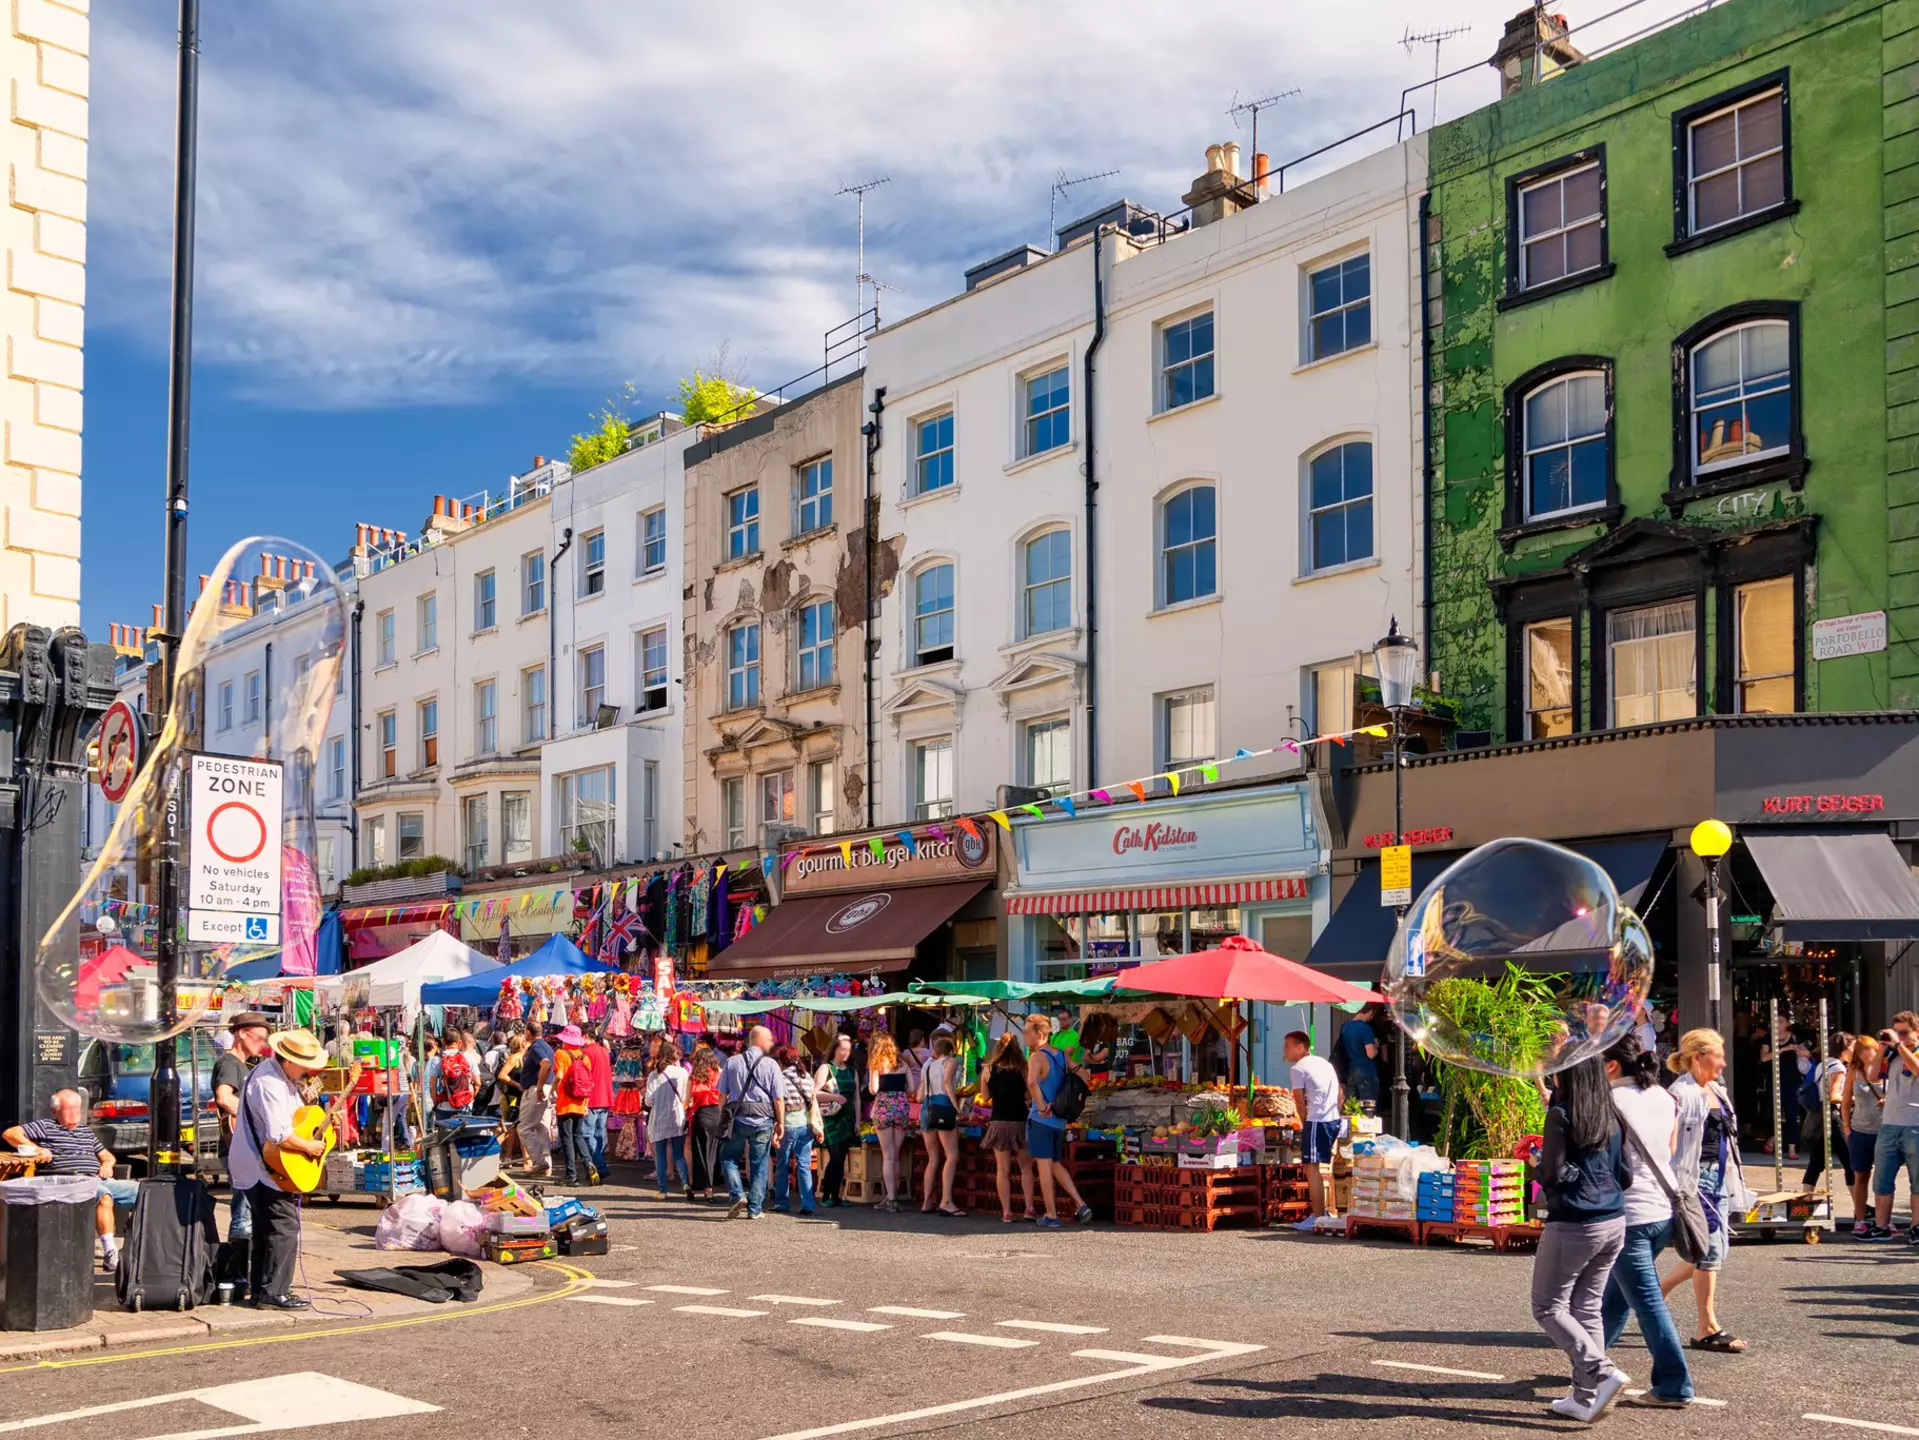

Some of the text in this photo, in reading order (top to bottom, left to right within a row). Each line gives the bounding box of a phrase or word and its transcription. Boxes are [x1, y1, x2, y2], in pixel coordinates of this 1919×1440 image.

[1717, 489, 1767, 516] CITY
[1815, 628, 1884, 646] PORTOBELLO
[197, 761, 278, 779] PEDESTRIAN
[209, 776, 266, 797] ZONE
[1763, 794, 1884, 814] KURT GEIGER
[1112, 822, 1198, 855] Cath Kidston
[1364, 826, 1453, 848] KUR GEIGER
[202, 865, 270, 879] No vehicles
[209, 881, 262, 895] Saturday
[200, 894, 213, 904] 10
[216, 897, 233, 905] am
[242, 897, 250, 906] 4
[253, 900, 270, 908] pm
[202, 921, 242, 933] Except
[656, 960, 672, 1008] SAL
[176, 995, 223, 1008] GERAN
[1116, 1038, 1134, 1047] BAG
